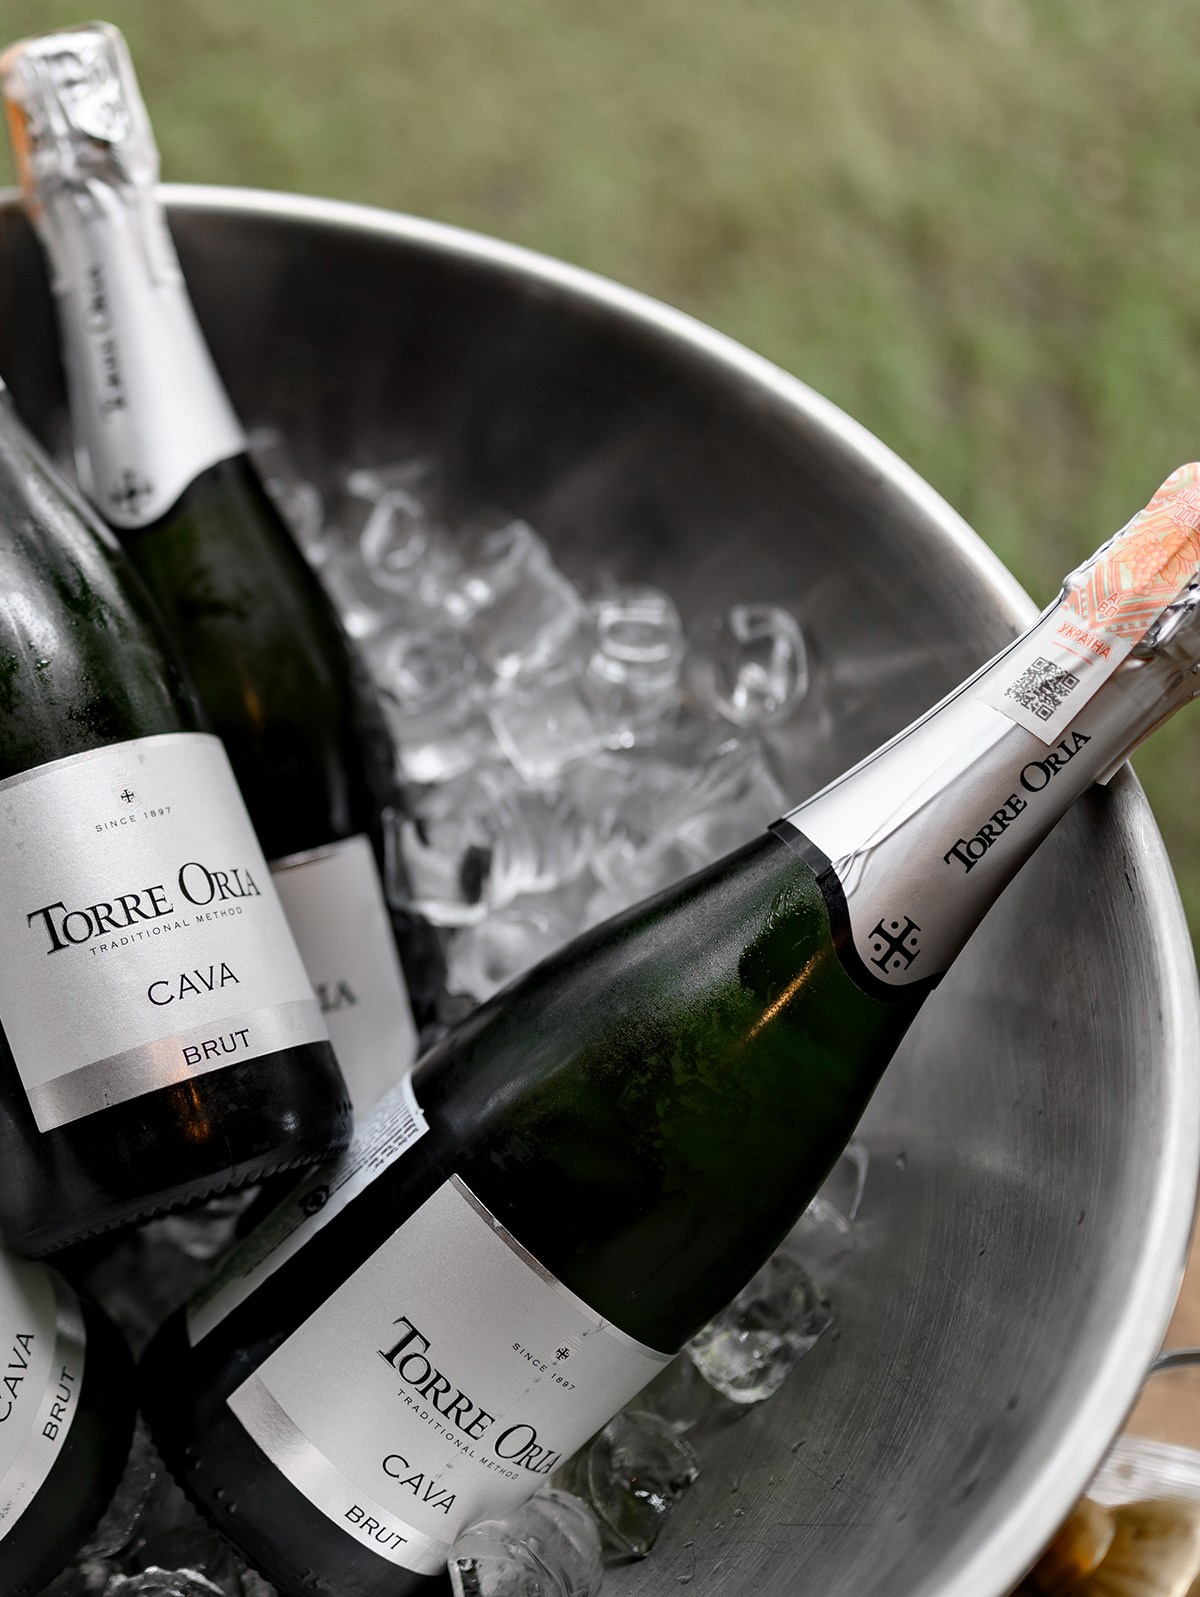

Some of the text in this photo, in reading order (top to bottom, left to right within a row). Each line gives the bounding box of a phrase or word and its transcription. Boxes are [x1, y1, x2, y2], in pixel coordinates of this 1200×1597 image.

[1057, 621, 1112, 661] УКРАЇНА
[94, 806, 173, 833] SINCE 1897
[943, 793, 1027, 874] TORRE
[1019, 730, 1091, 793] ORIA
[26, 862, 261, 956] TORRE ORIA
[89, 906, 243, 956] TRADITIONAL METHOD
[147, 962, 240, 1007] CAVA
[182, 1029, 251, 1066] BRUT
[512, 1342, 576, 1392] SINCE 1897
[42, 1365, 77, 1442] BRUT
[377, 1316, 563, 1475] TORRE ORIA
[396, 1389, 519, 1481] TRADITIONAL METHOD
[381, 1453, 457, 1515] CAVA
[344, 1505, 408, 1551] BRUT
